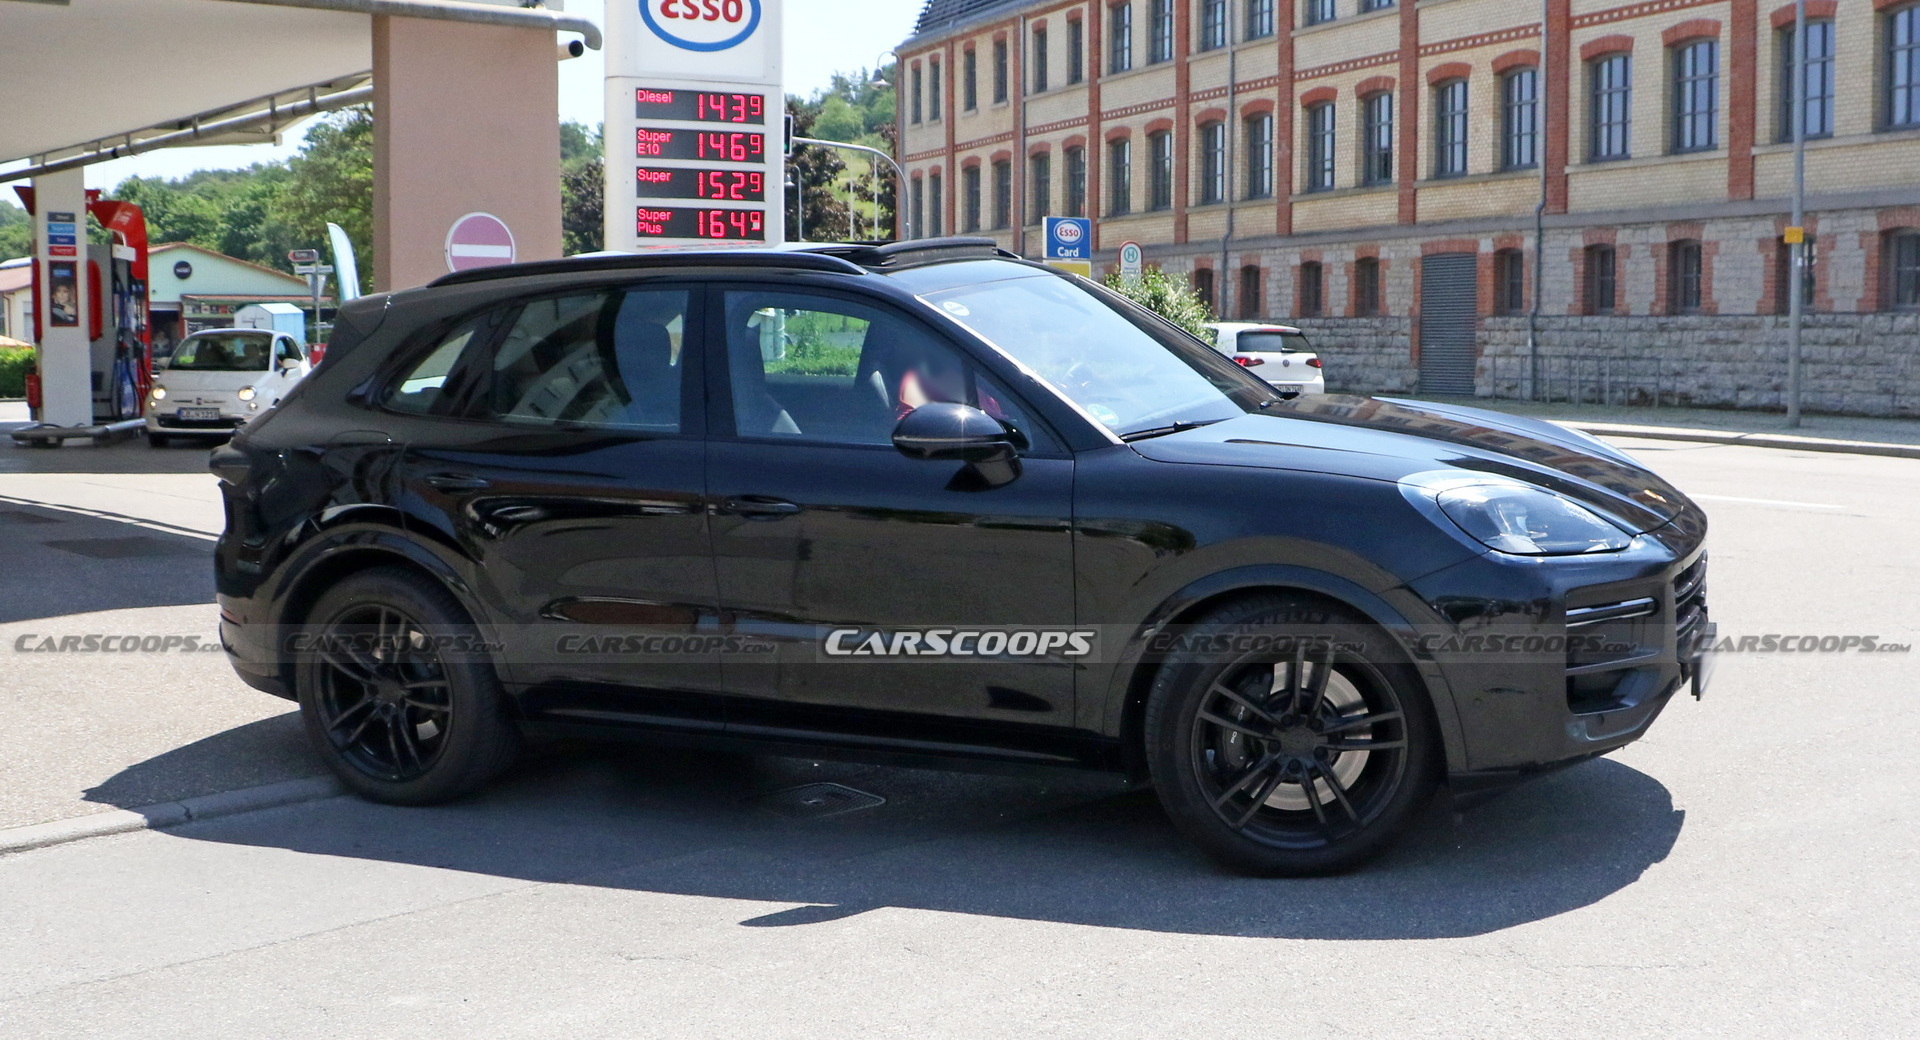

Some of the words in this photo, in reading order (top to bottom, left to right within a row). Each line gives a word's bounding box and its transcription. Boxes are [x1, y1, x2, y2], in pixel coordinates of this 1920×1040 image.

[637, 90, 672, 103] Diesel
[637, 129, 671, 144] Super
[637, 143, 660, 155] E10
[637, 168, 671, 183] Super
[638, 208, 671, 222] Super
[638, 222, 662, 234] Plus
[1059, 226, 1079, 237] Esso
[1057, 246, 1079, 257] Card
[1127, 250, 1135, 260] H
